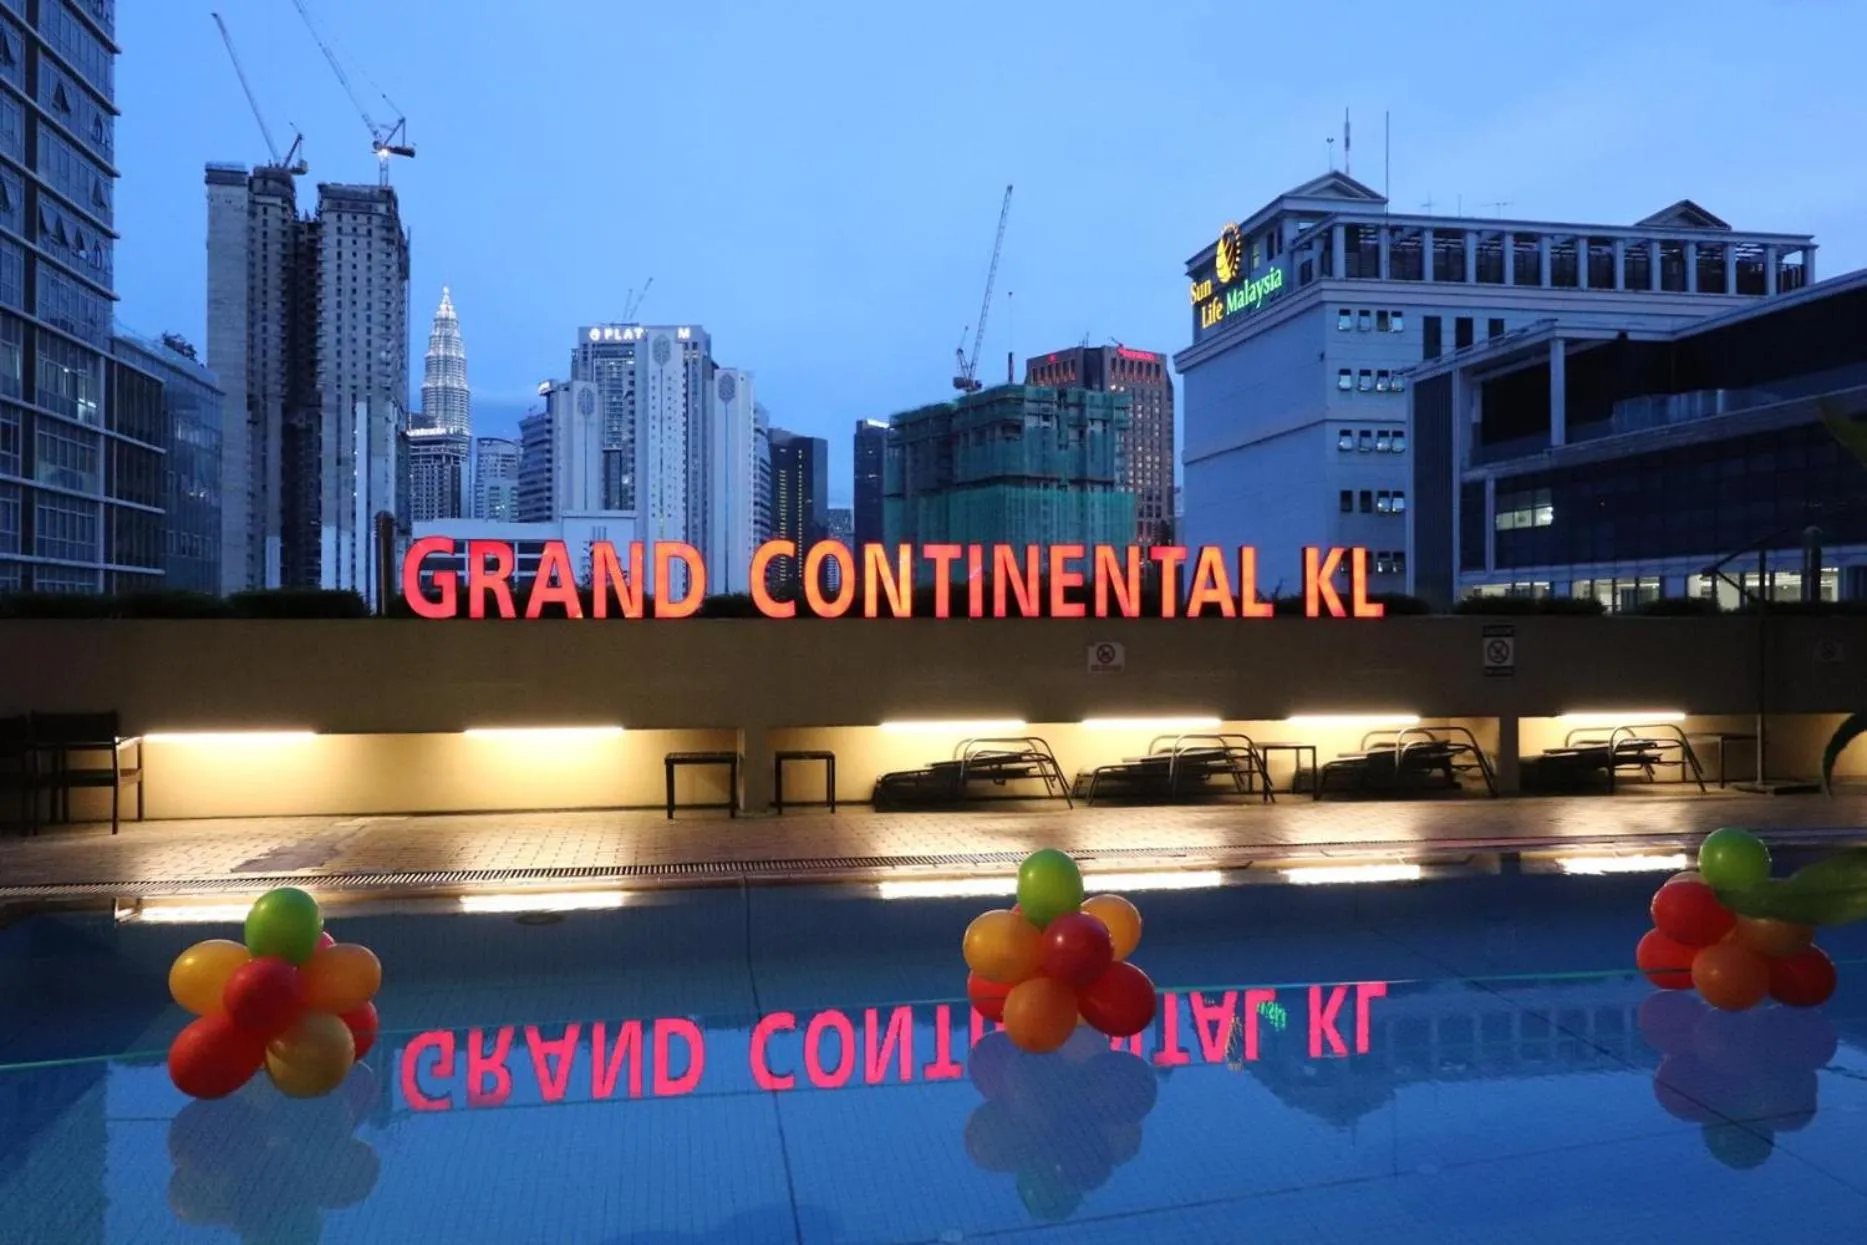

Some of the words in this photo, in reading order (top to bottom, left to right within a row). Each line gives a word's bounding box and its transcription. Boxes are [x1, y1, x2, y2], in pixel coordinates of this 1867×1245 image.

[1190, 279, 1213, 304] Sun
[1201, 297, 1224, 328] Life
[1226, 267, 1283, 315] Malaysia
[404, 537, 706, 618] GRAND
[750, 540, 1273, 617] CONTINENTAL
[1306, 548, 1383, 617] KL
